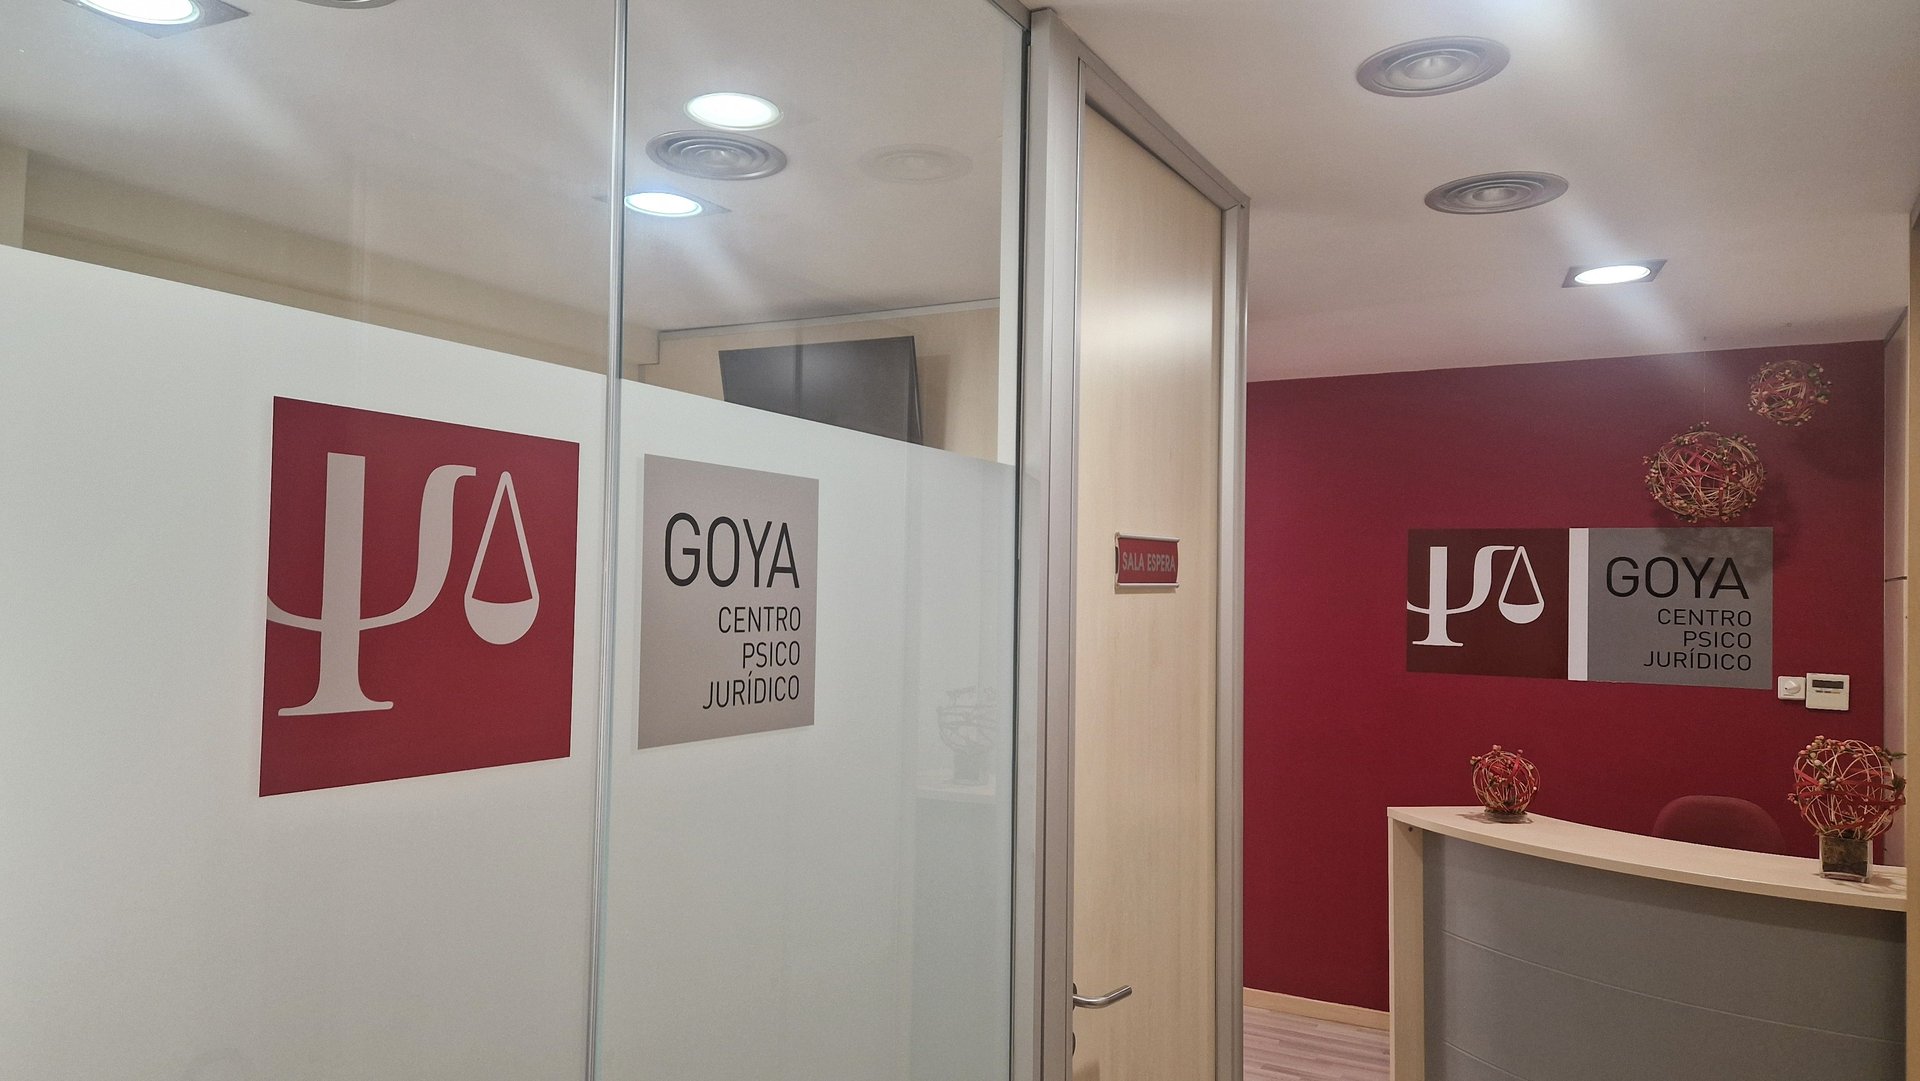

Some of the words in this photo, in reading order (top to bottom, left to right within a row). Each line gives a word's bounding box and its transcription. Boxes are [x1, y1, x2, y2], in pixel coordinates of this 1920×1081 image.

[665, 512, 800, 588] GOYA
[1122, 551, 1145, 571] SALA
[1147, 552, 1176, 572] ESPERA
[1606, 556, 1750, 599] GOYA
[718, 606, 801, 634] CENTRO
[1657, 608, 1751, 627] CENTRO
[1683, 630, 1751, 649] PSICO
[742, 640, 800, 669] PSICO
[1643, 648, 1751, 671] JURÍDICO
[702, 670, 800, 710] JURÍDICO
